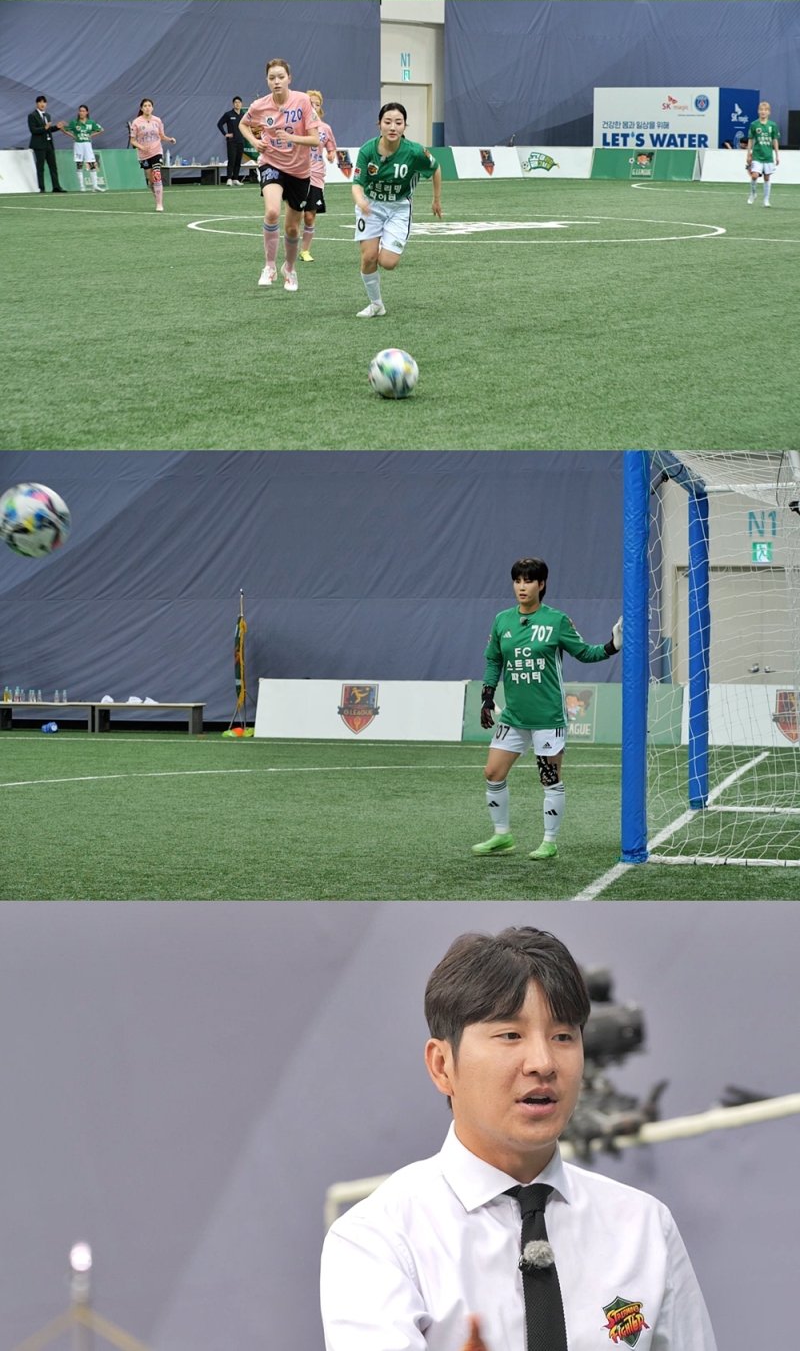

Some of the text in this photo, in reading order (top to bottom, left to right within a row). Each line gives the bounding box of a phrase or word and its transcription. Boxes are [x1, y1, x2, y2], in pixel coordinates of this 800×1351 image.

[400, 52, 410, 67] N1
[661, 102, 672, 110] SK
[284, 109, 303, 124] 720
[602, 120, 621, 129] 건강한
[636, 120, 656, 129] 일상을
[657, 121, 670, 129] 위해
[602, 132, 709, 148] LET'S WATER
[394, 163, 408, 179] 10
[748, 510, 776, 537] N1
[531, 625, 554, 642] 707
[514, 647, 532, 658] FC
[507, 658, 546, 671] 스트리밍
[511, 671, 542, 684] 파이터
[496, 725, 511, 741] 07
